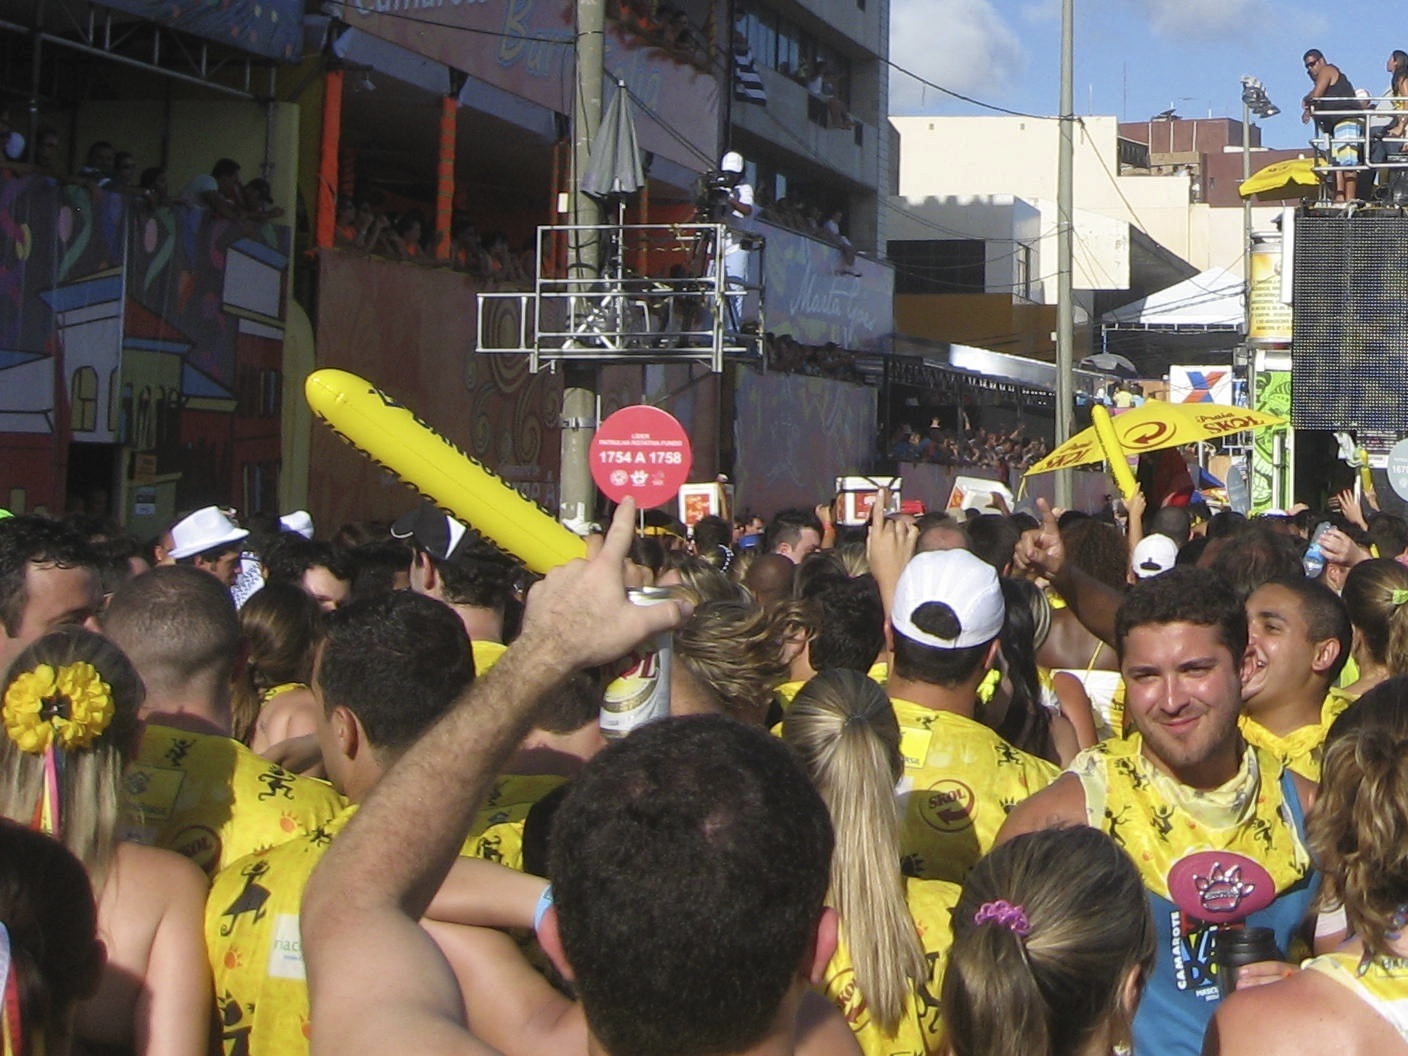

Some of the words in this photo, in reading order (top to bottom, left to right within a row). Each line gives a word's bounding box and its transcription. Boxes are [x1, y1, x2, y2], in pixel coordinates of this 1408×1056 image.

[1203, 416, 1265, 434] SKOL
[599, 451, 632, 463] 1754
[634, 452, 646, 463] A
[649, 452, 682, 464] 1758
[929, 789, 966, 809] SKOL
[1171, 910, 1188, 991] CAMAROTE
